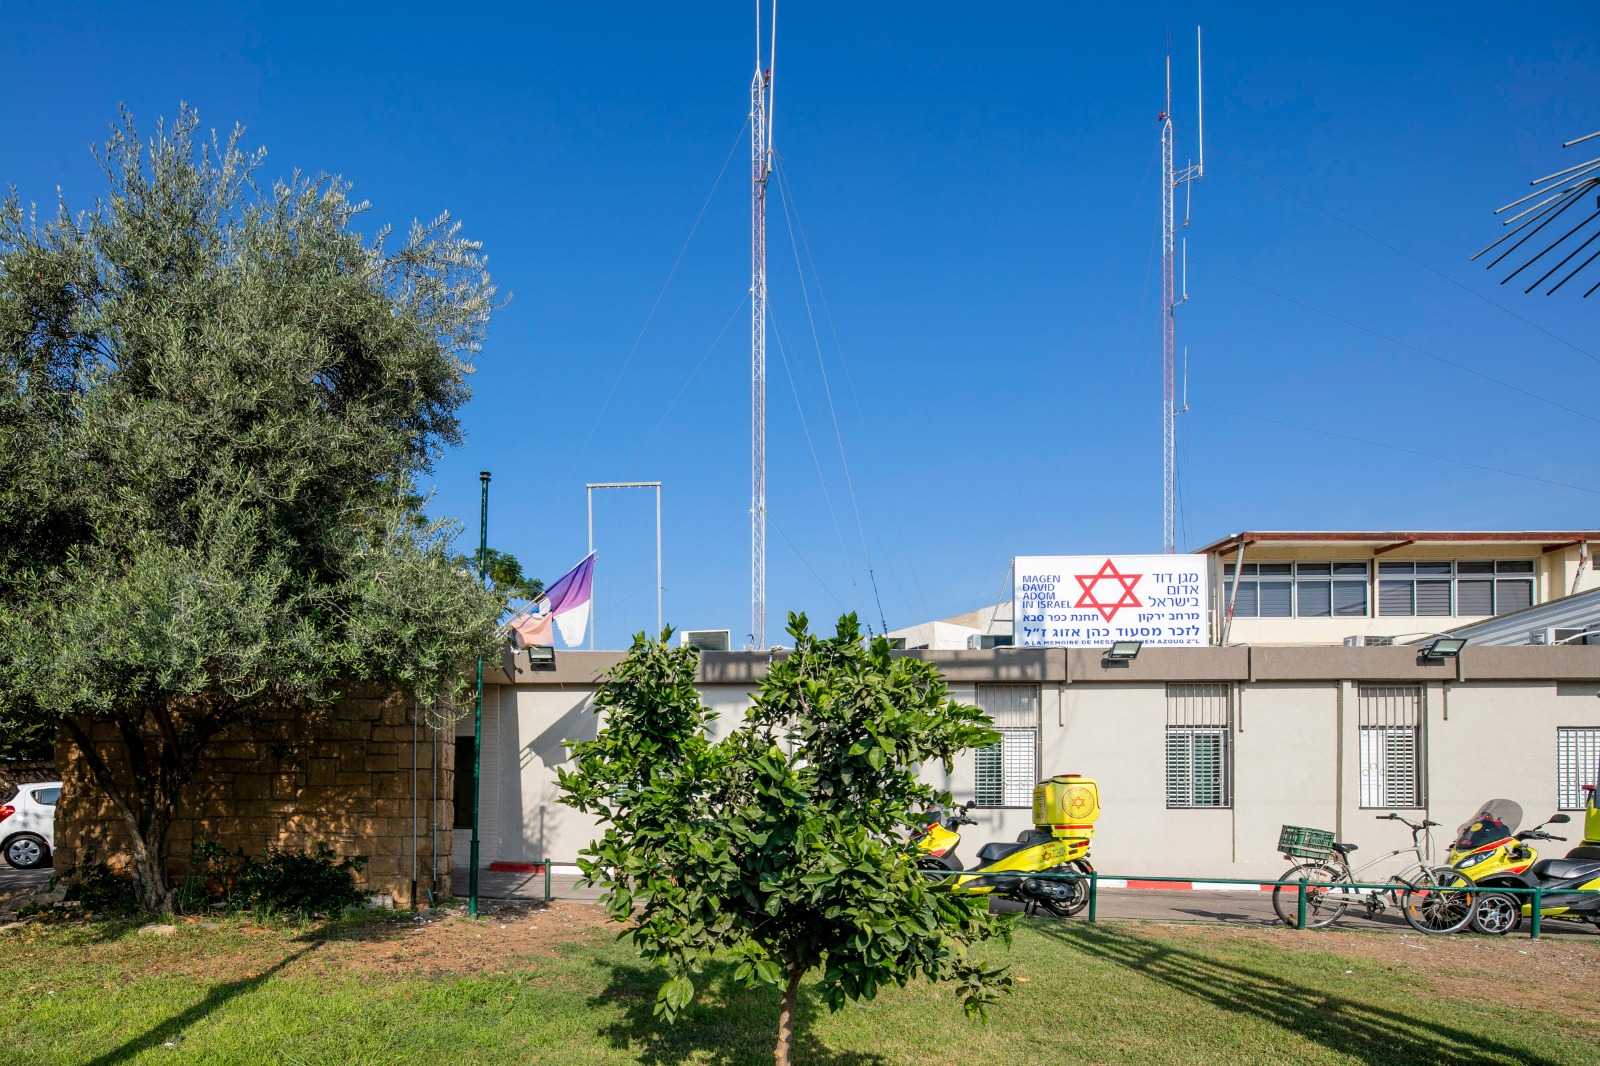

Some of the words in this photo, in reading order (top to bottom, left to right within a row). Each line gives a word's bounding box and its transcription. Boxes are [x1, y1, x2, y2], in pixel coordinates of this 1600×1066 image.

[1022, 575, 1061, 583] MAGEN
[1152, 573, 1173, 583] דוד
[1178, 573, 1199, 584] מגן
[1022, 584, 1055, 592] DAVID
[1167, 585, 1199, 595] אדום
[1022, 592, 1056, 600] ADOM
[1022, 600, 1034, 608] IN
[1037, 600, 1072, 608] ISRAEL
[1148, 596, 1200, 608] בישראל
[1138, 613, 1165, 622] ירקון
[1052, 628, 1081, 638] אזוג
[1086, 627, 1110, 639] כהן
[1115, 626, 1162, 638] מסעוד
[1168, 625, 1200, 636] לזכר
